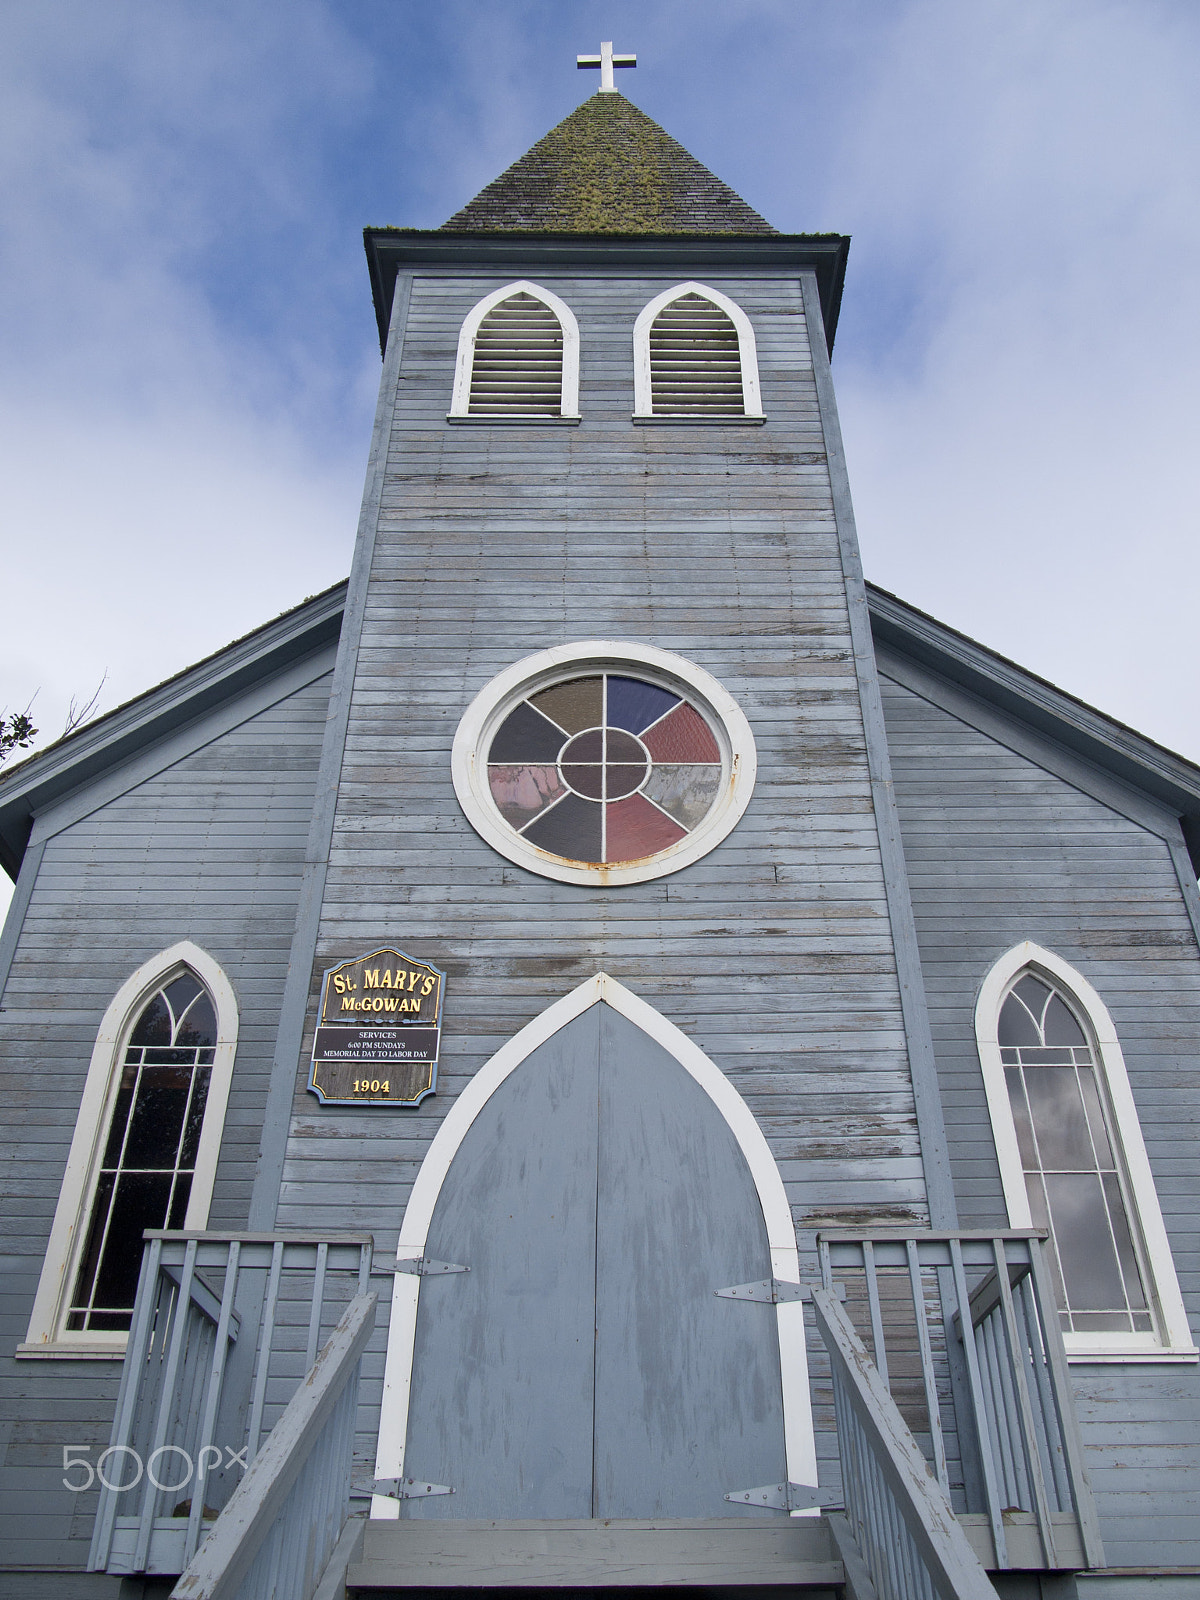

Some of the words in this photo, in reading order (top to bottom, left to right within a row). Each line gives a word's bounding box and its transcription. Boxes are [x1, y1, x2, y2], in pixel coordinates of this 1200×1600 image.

[333, 974, 357, 994] St.
[364, 970, 435, 996] MARY'S
[341, 998, 422, 1012] McGOWAN
[353, 1080, 390, 1092] 1904
